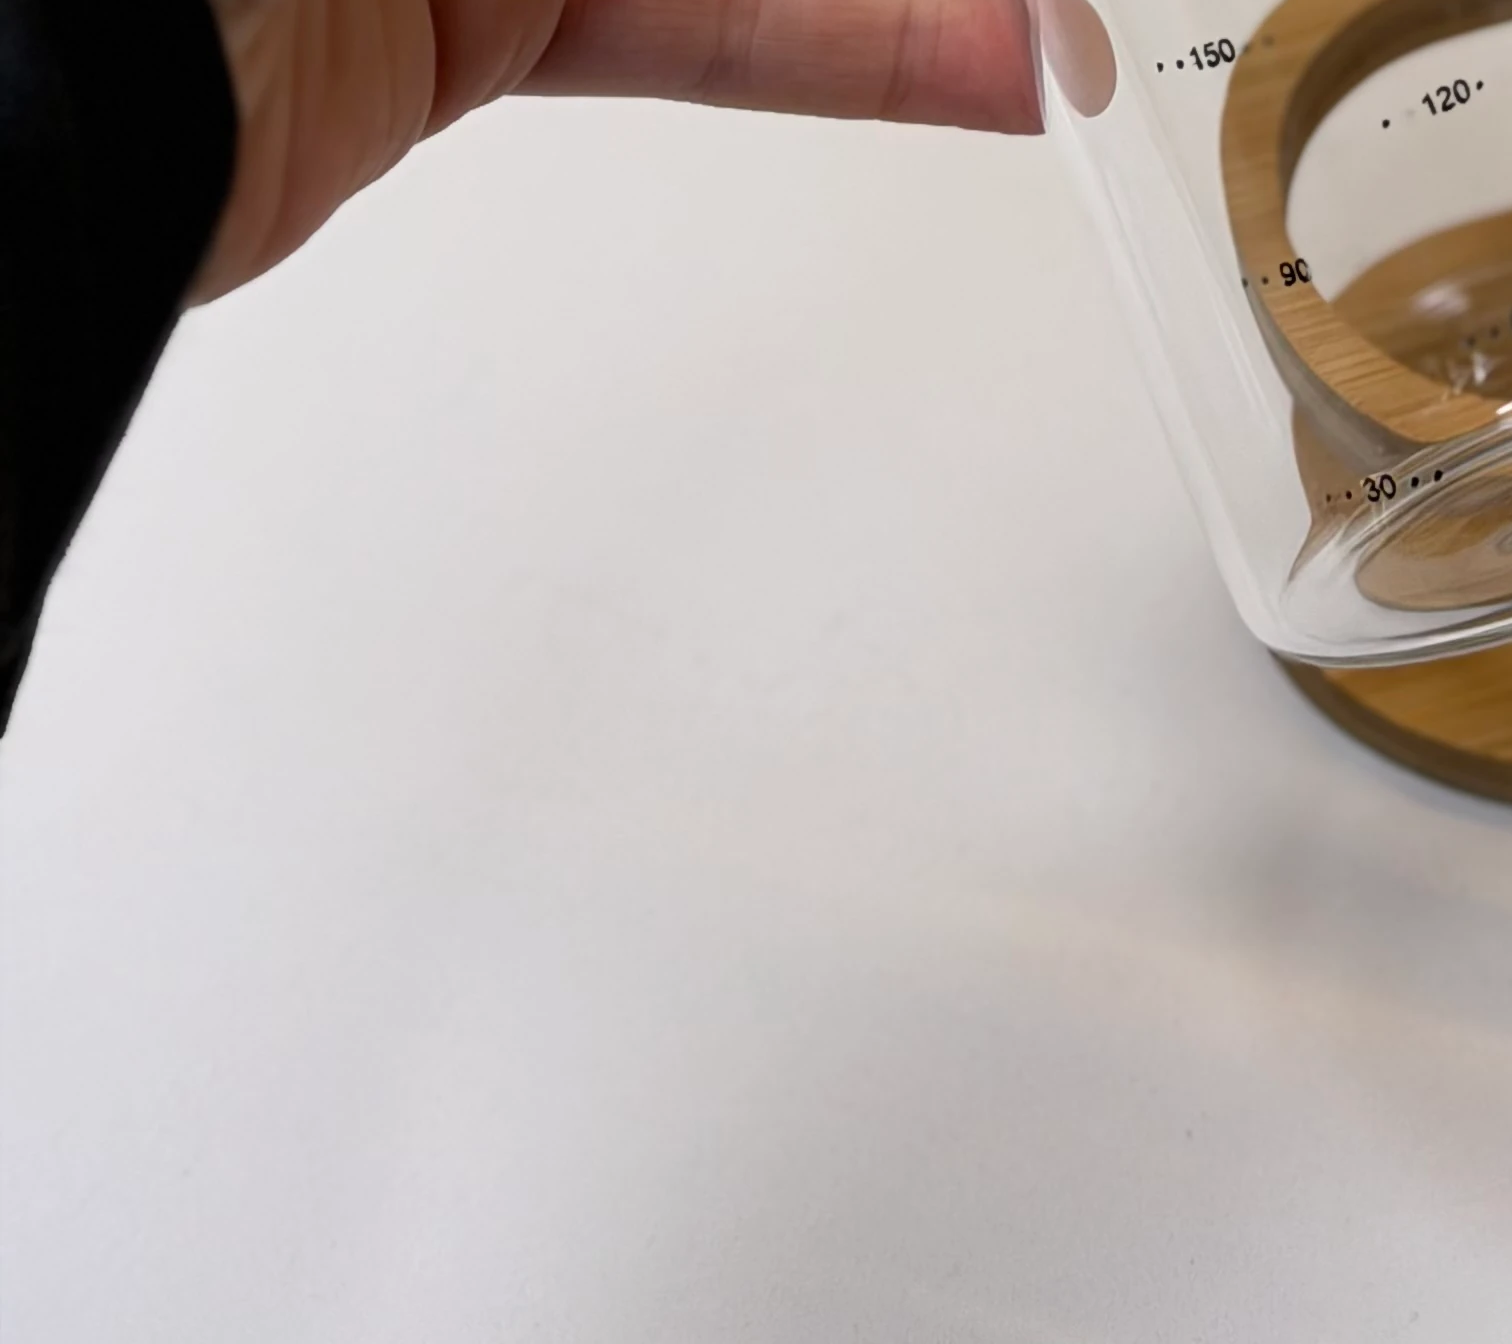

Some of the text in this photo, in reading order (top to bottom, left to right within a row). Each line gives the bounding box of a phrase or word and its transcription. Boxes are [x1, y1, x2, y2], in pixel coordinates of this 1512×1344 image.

[1188, 38, 1236, 71] 150
[1421, 79, 1471, 117] 120
[1279, 258, 1312, 287] 90
[1362, 473, 1397, 503] 30
